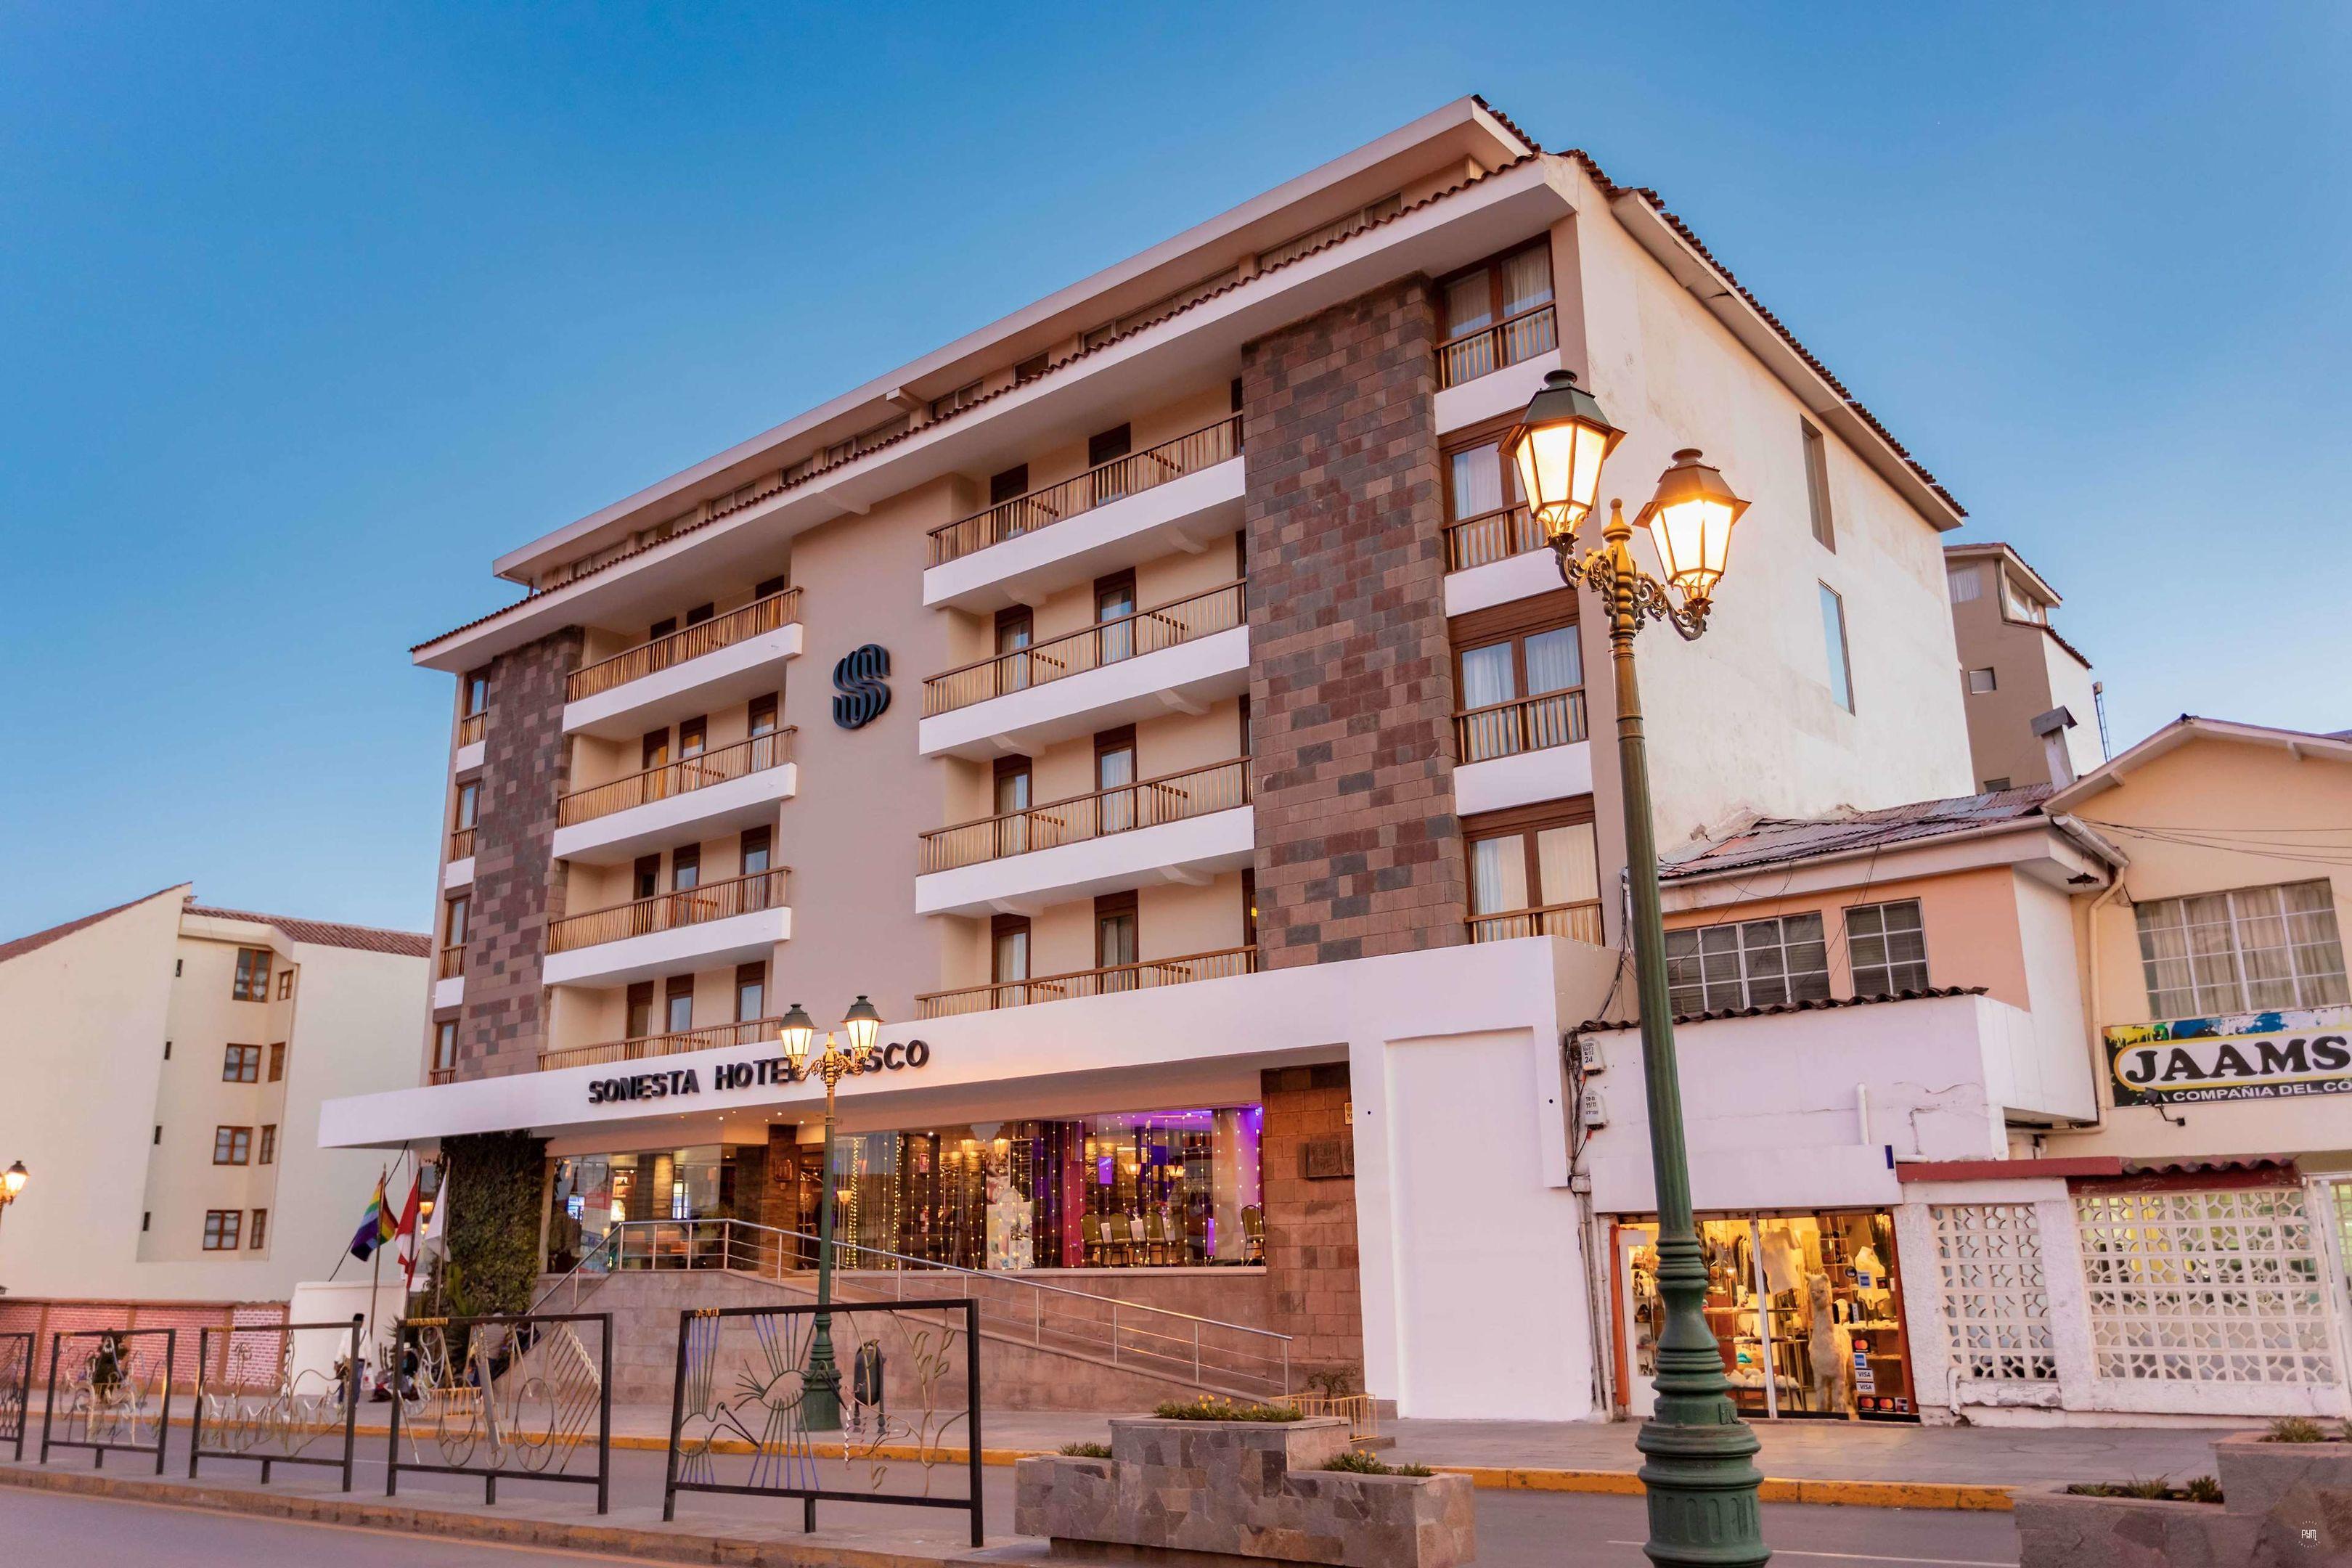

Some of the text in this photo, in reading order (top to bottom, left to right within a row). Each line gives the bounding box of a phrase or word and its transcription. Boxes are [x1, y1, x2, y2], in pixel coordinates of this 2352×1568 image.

[2126, 1036, 2351, 1083] JAAMS
[589, 1070, 700, 1103] SONESTA
[2173, 1086, 2274, 1101] COMPAÑIA
[2279, 1083, 2318, 1095] DEL
